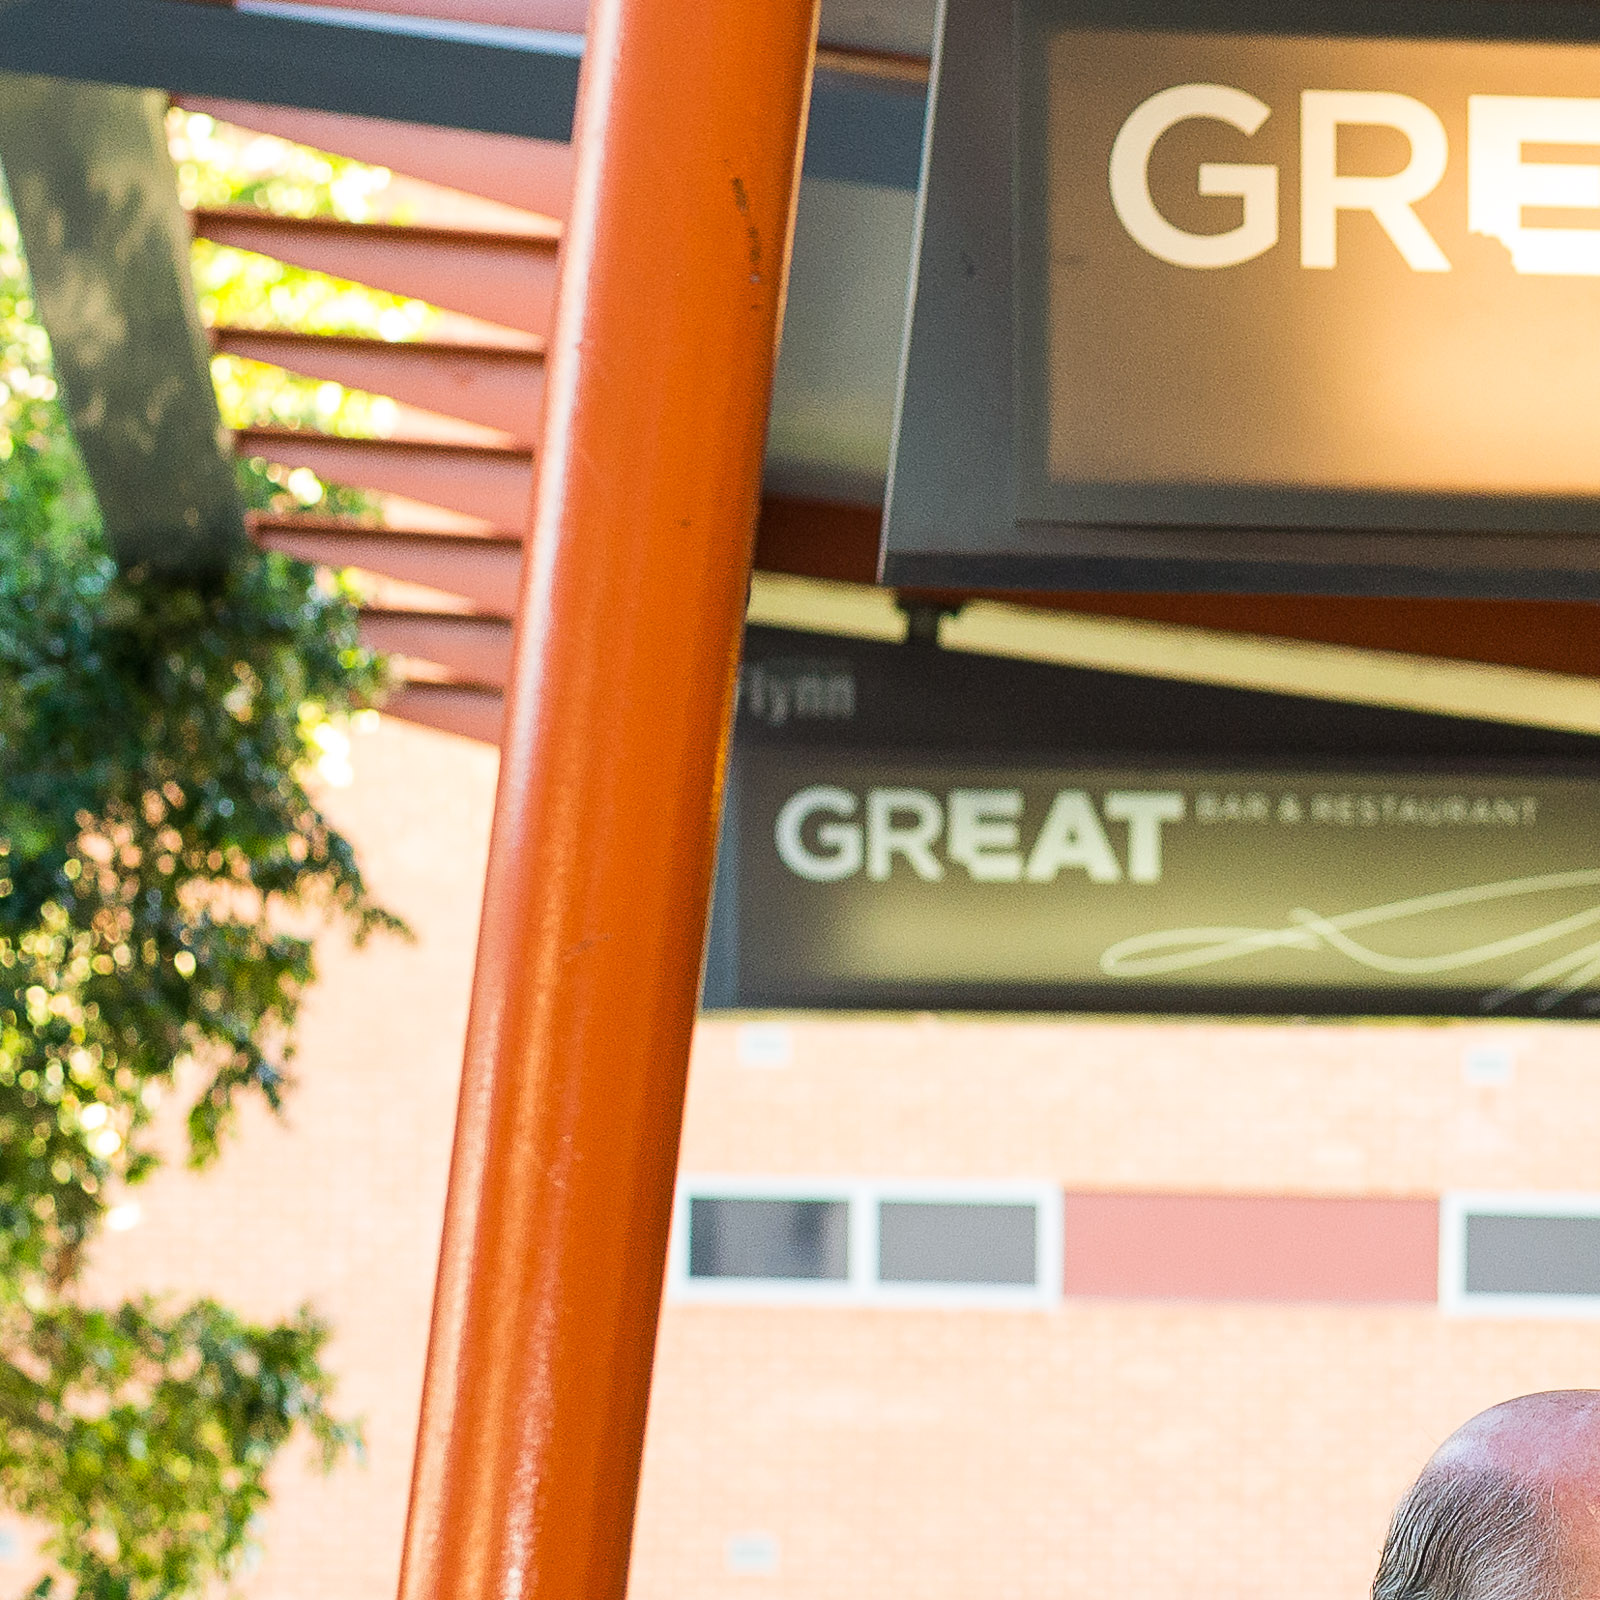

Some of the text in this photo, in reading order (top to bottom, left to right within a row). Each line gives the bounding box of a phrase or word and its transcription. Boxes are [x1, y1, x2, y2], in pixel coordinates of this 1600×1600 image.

[775, 786, 1537, 883] GREAT BAR & RESTAURANT
